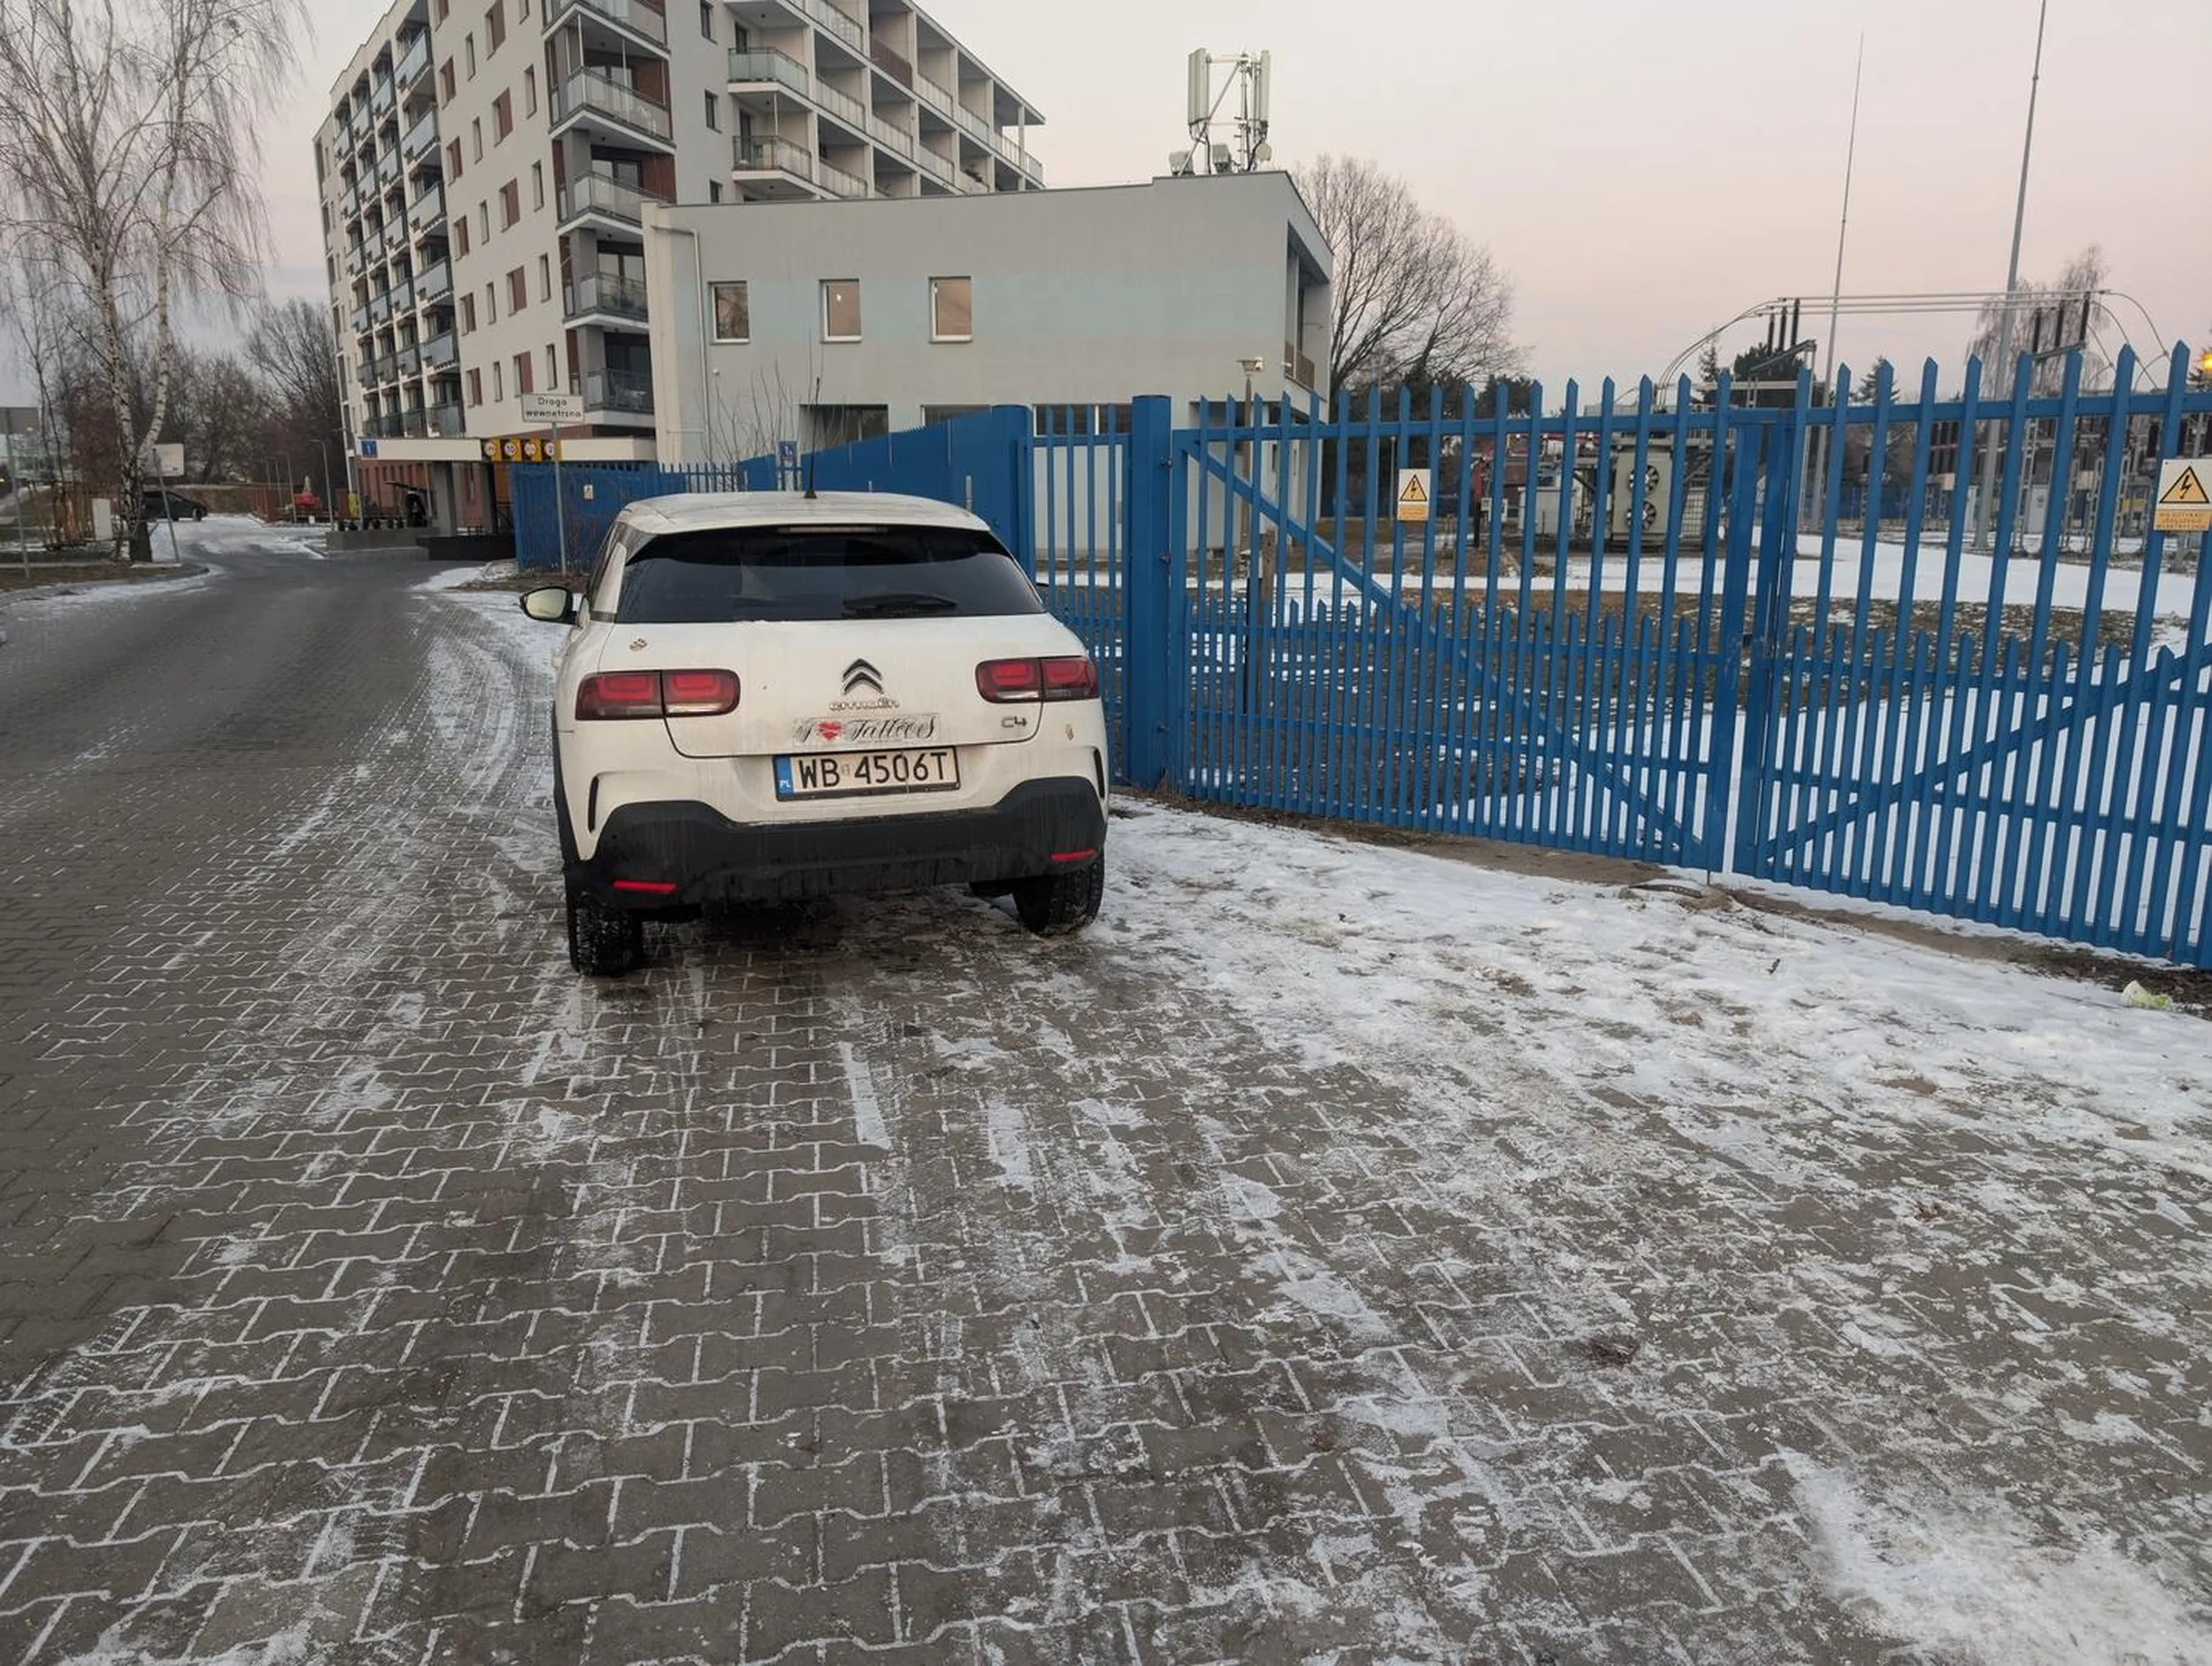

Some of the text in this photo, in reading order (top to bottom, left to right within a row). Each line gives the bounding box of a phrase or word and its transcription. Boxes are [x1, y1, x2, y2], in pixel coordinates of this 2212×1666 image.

[538, 396, 567, 407] Droga
[1002, 716, 1027, 728] C4
[799, 752, 948, 788] WB 4506T
[780, 779, 791, 788] PL
